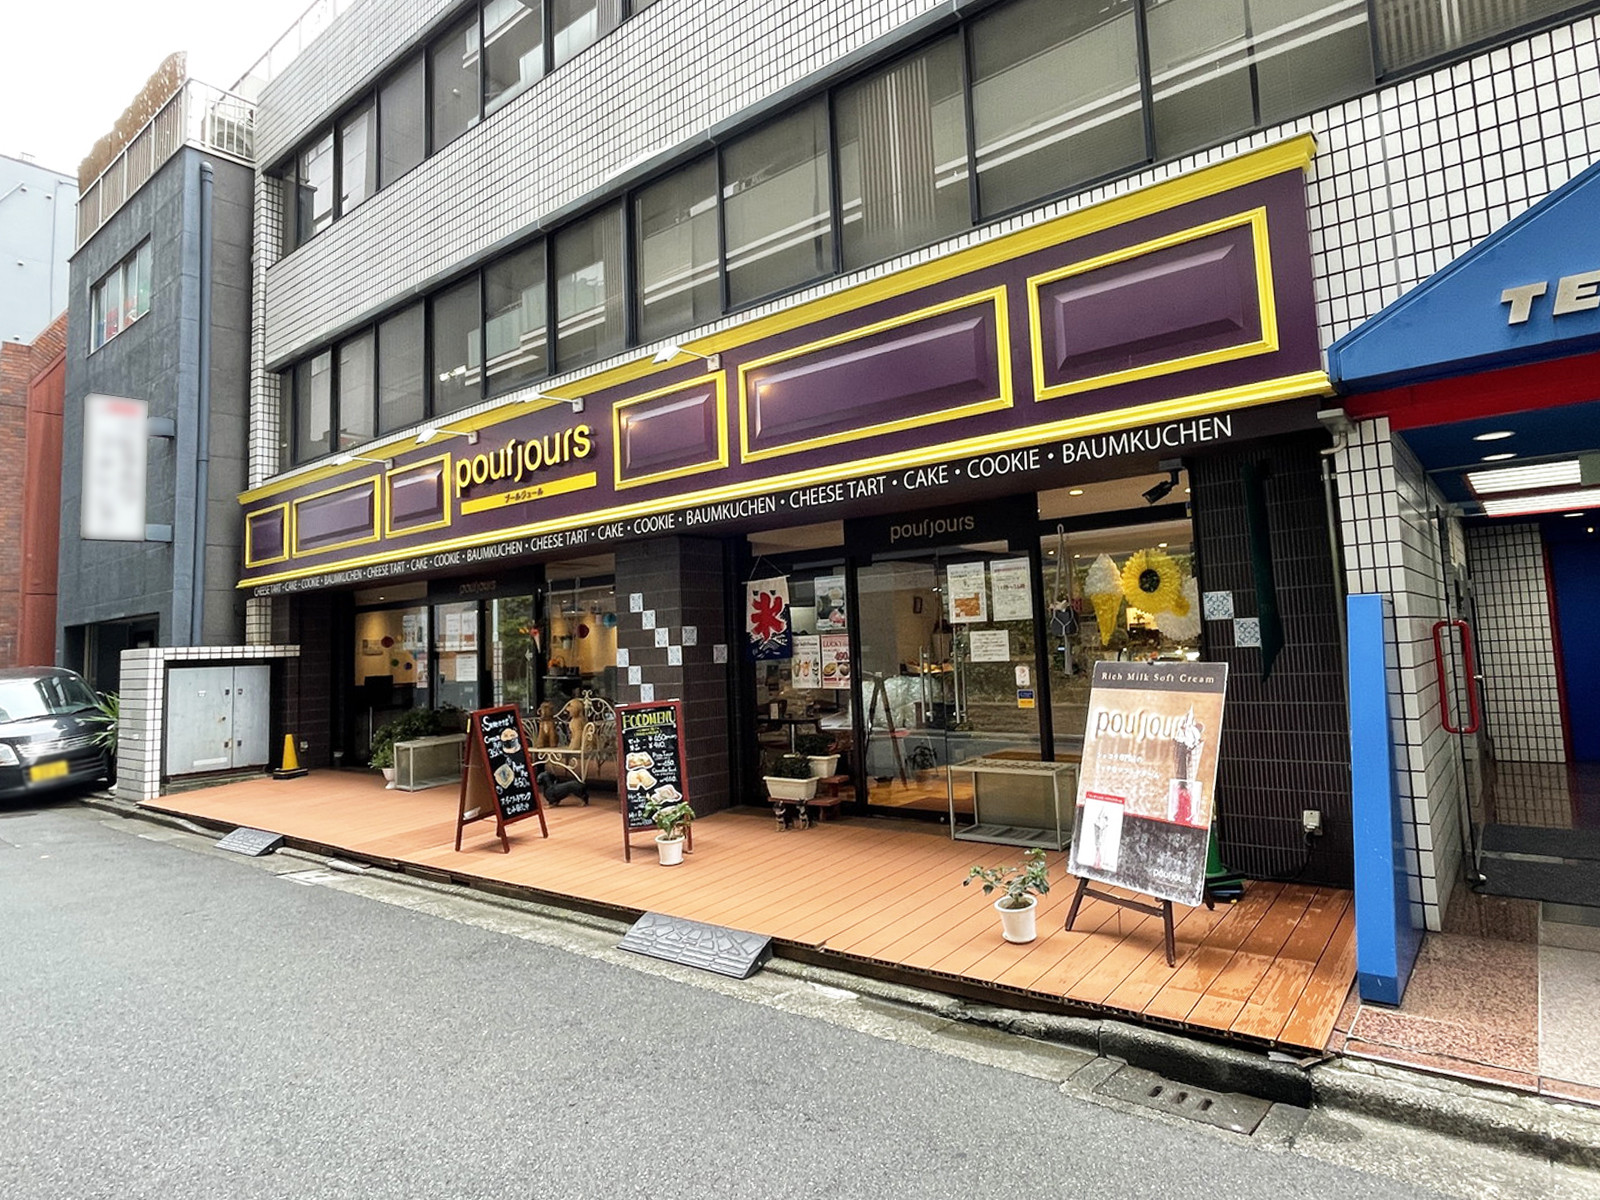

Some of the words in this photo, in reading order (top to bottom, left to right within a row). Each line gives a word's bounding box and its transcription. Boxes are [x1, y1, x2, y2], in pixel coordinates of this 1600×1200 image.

[366, 563, 390, 579] CHEESE
[389, 560, 405, 576] TART
[410, 556, 429, 571] CAKE
[433, 552, 461, 568] COOKIE
[466, 541, 523, 563] BAUMKUCHEN
[530, 534, 565, 552] CHEESE
[564, 528, 589, 546] TART
[597, 522, 624, 541] CAKE
[633, 513, 676, 535] COOKIE
[686, 495, 776, 526] BAUMKUCHEN
[789, 484, 845, 509] CHEESE
[846, 475, 888, 499] TART
[903, 465, 950, 490] CAKE
[966, 448, 1041, 480] COOKIE
[1062, 414, 1233, 464] BAUMKUCHEN
[1101, 672, 1123, 681] Rich
[1127, 672, 1150, 682] Milk
[1153, 673, 1175, 682] Soft
[1179, 673, 1215, 684] Cream
[622, 713, 650, 729] FOOD
[649, 710, 676, 725] MENU
